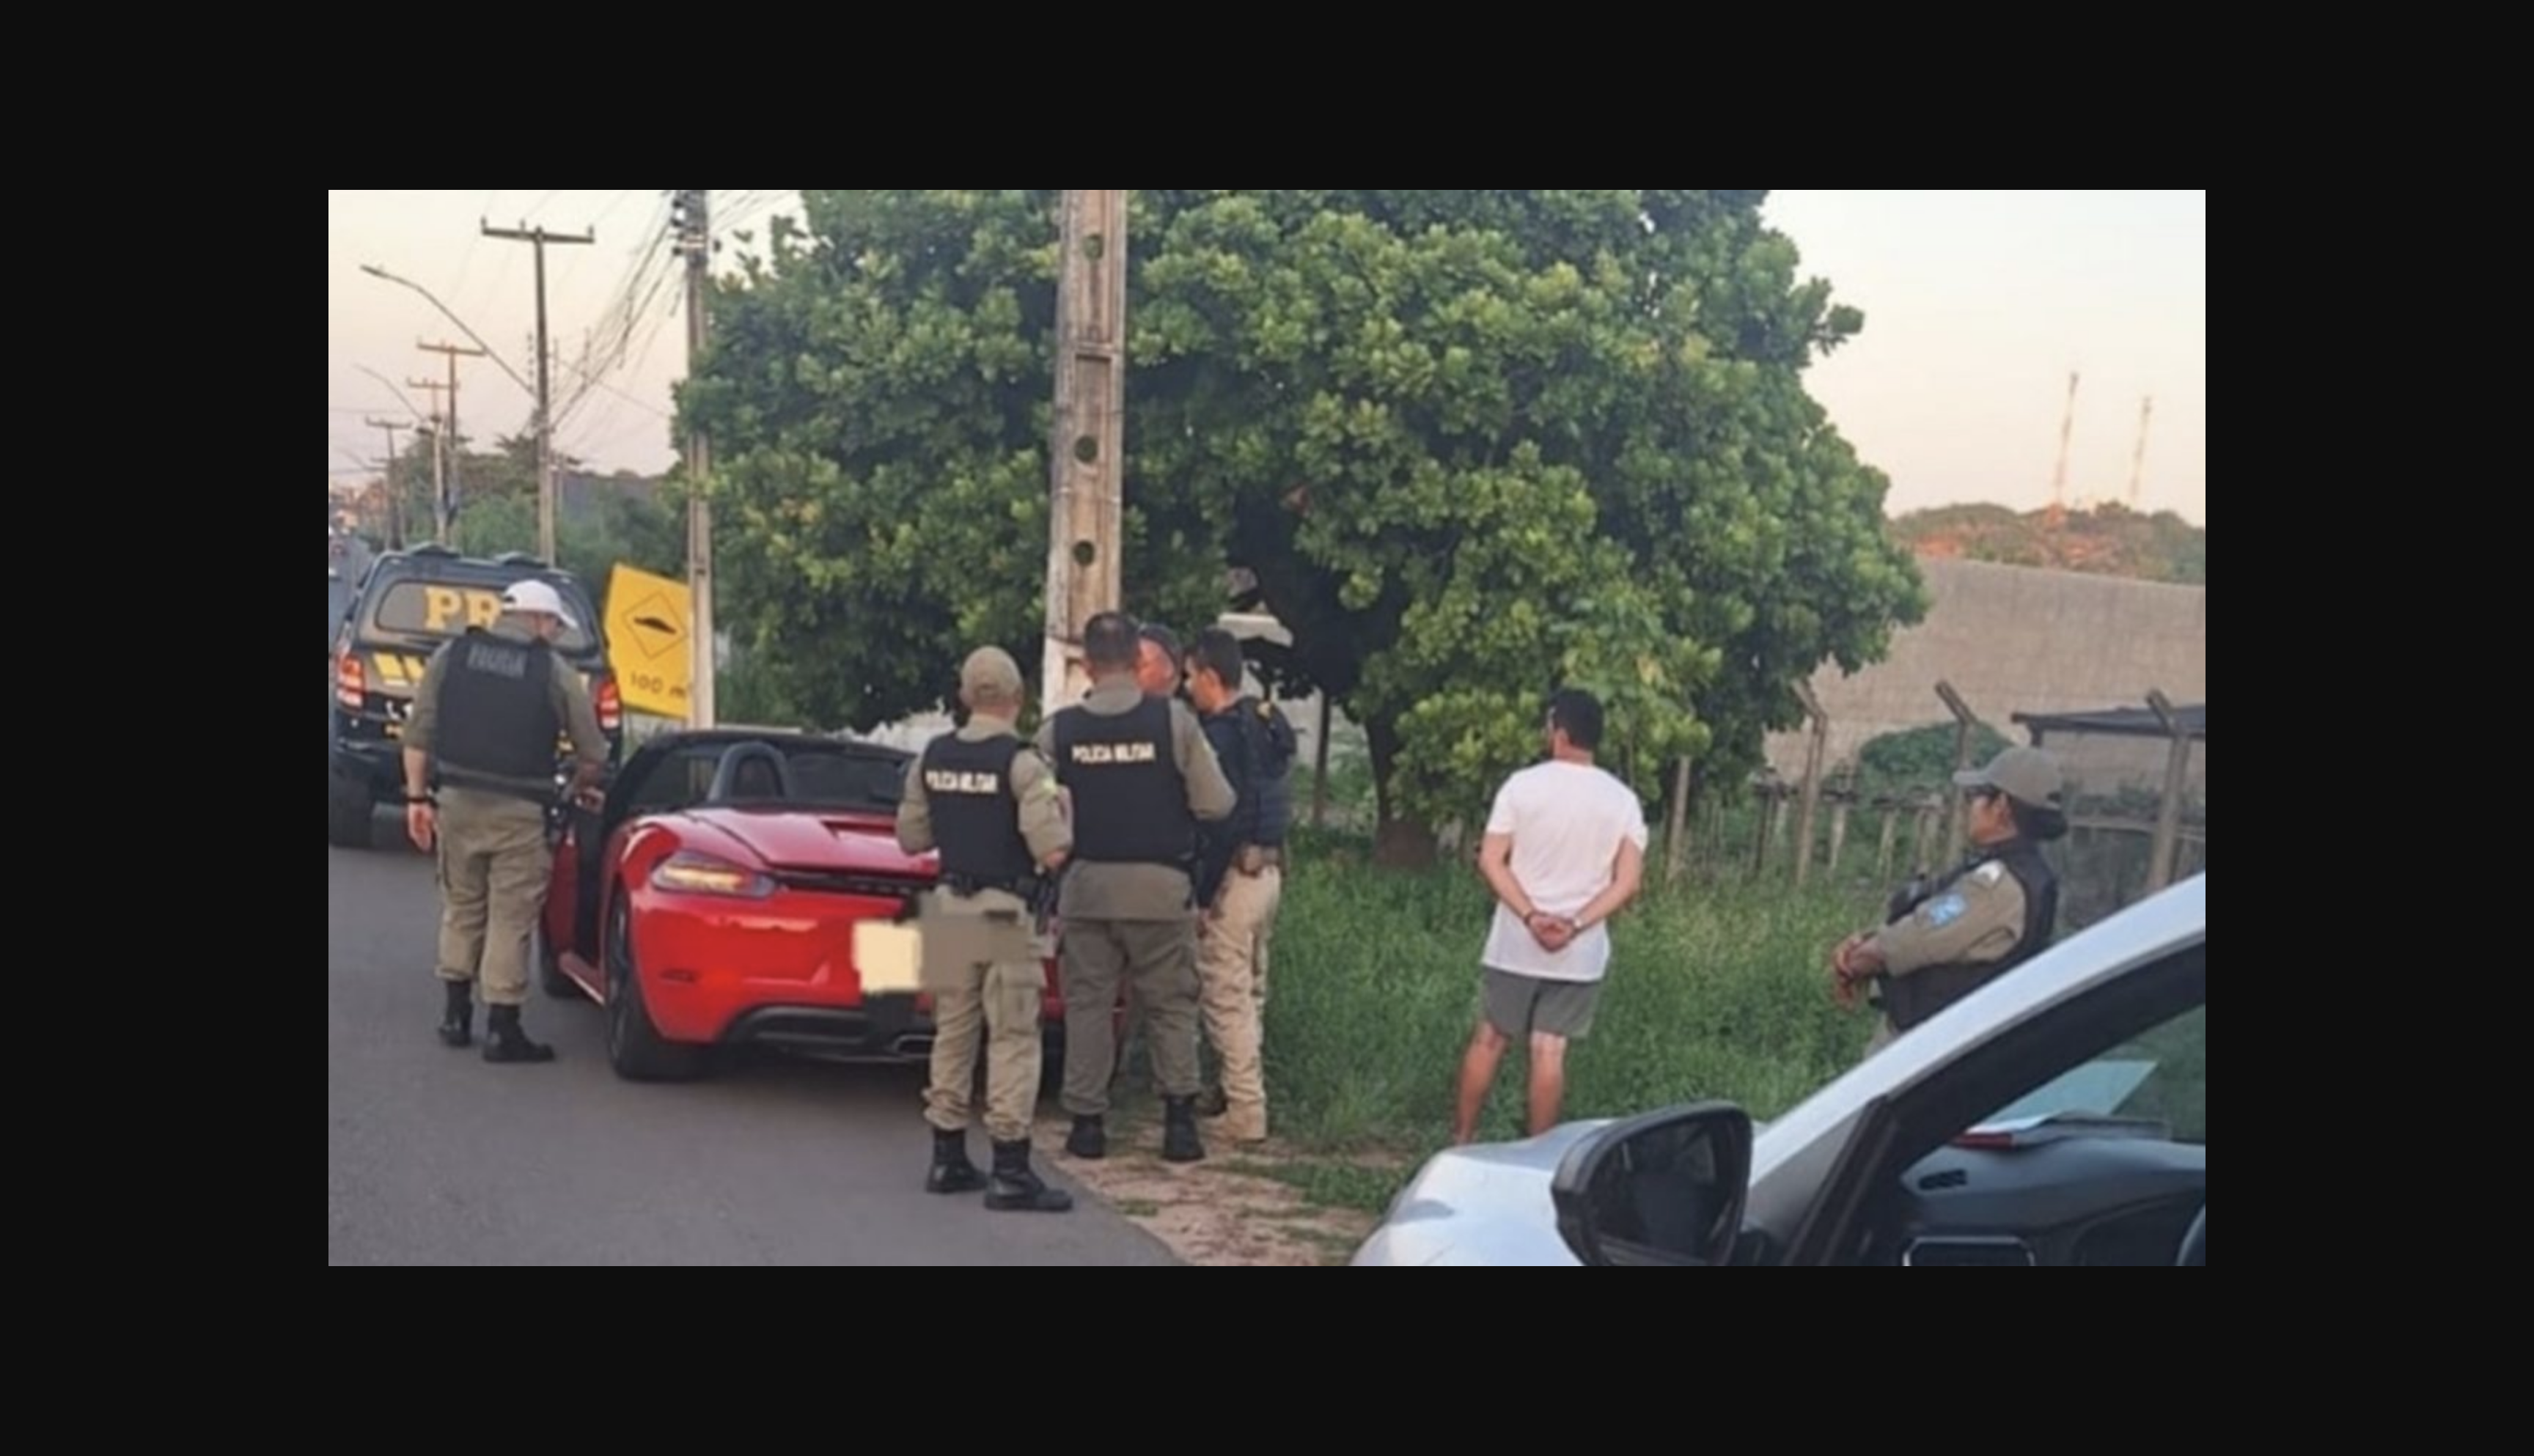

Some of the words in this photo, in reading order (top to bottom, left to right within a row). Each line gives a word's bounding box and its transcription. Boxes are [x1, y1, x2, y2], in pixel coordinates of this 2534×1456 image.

[424, 587, 502, 630] PR
[631, 670, 664, 695] 100
[1114, 742, 1156, 762] MILITAR
